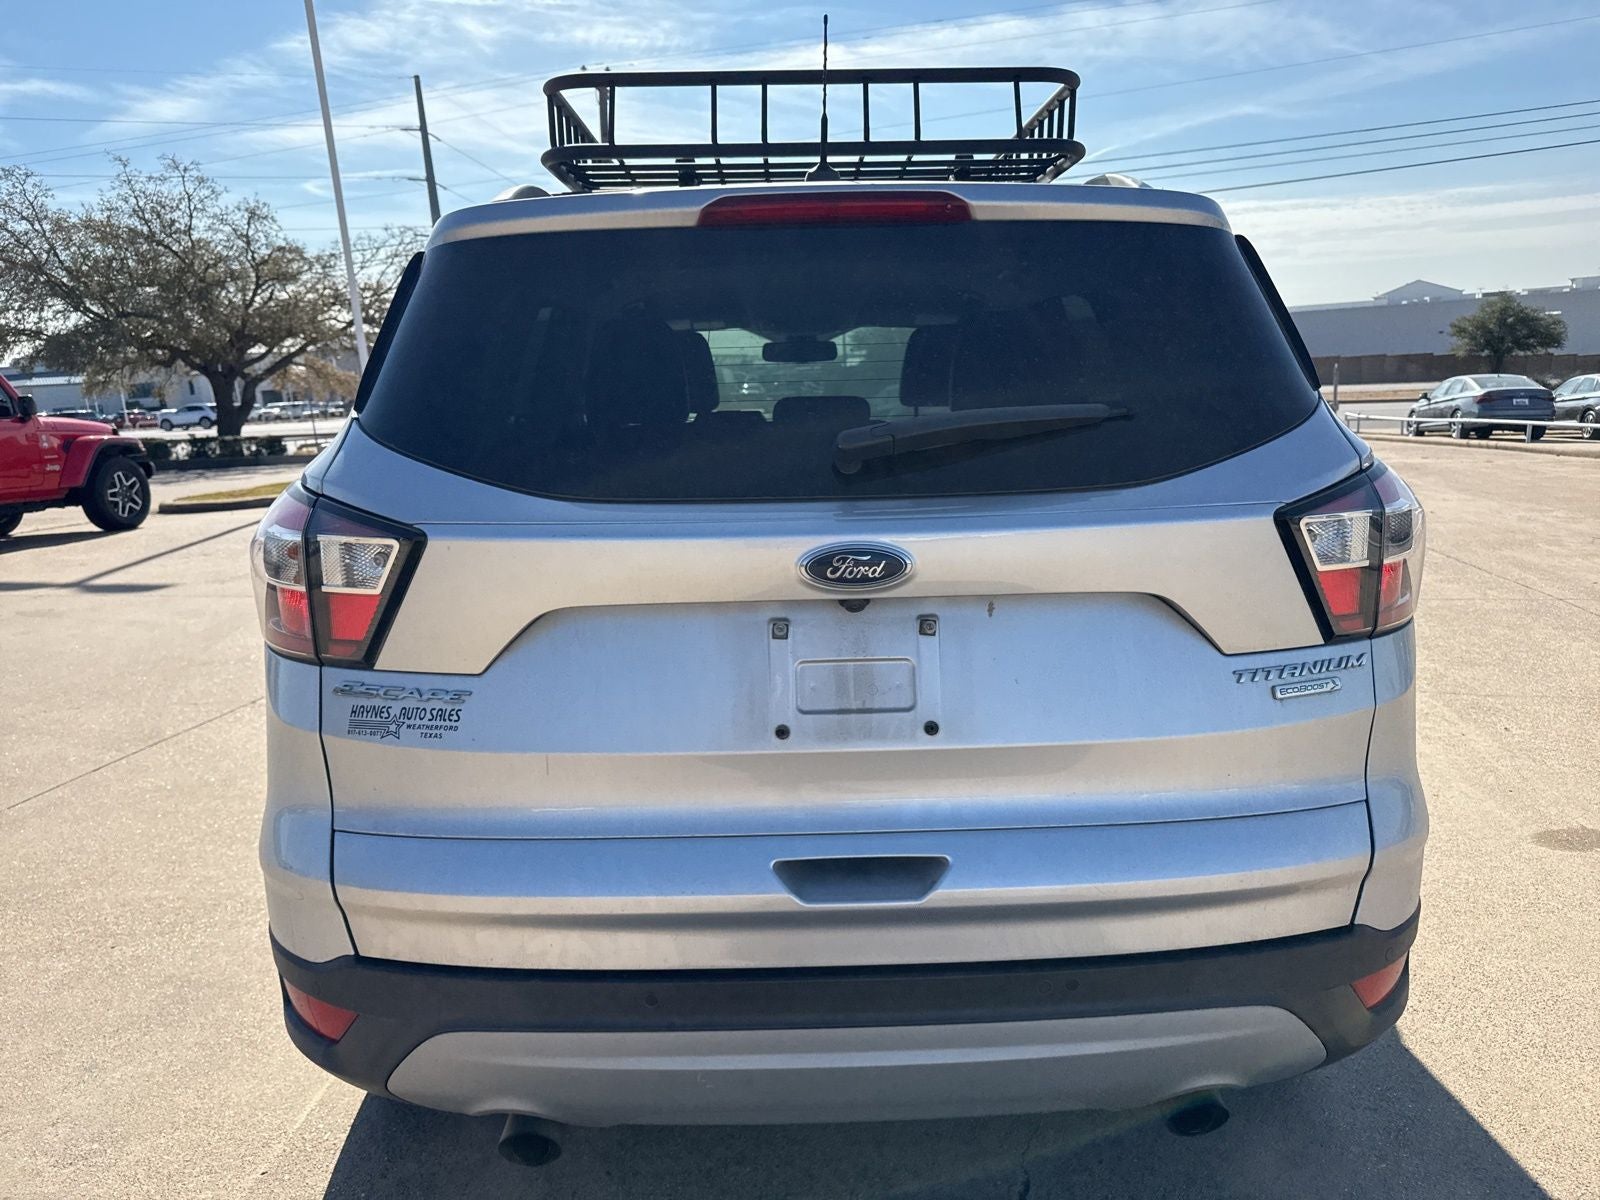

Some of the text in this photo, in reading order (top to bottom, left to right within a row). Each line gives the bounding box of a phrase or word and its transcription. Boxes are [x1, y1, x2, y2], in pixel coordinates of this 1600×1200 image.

[826, 554, 886, 579] Ford
[1232, 652, 1367, 684] TITANIUM
[332, 680, 473, 704] ESCAPE
[1279, 680, 1330, 696] ECOBOOST
[350, 704, 462, 723] HAYNES AUTO SALES
[406, 723, 459, 732] WEATHERFORD
